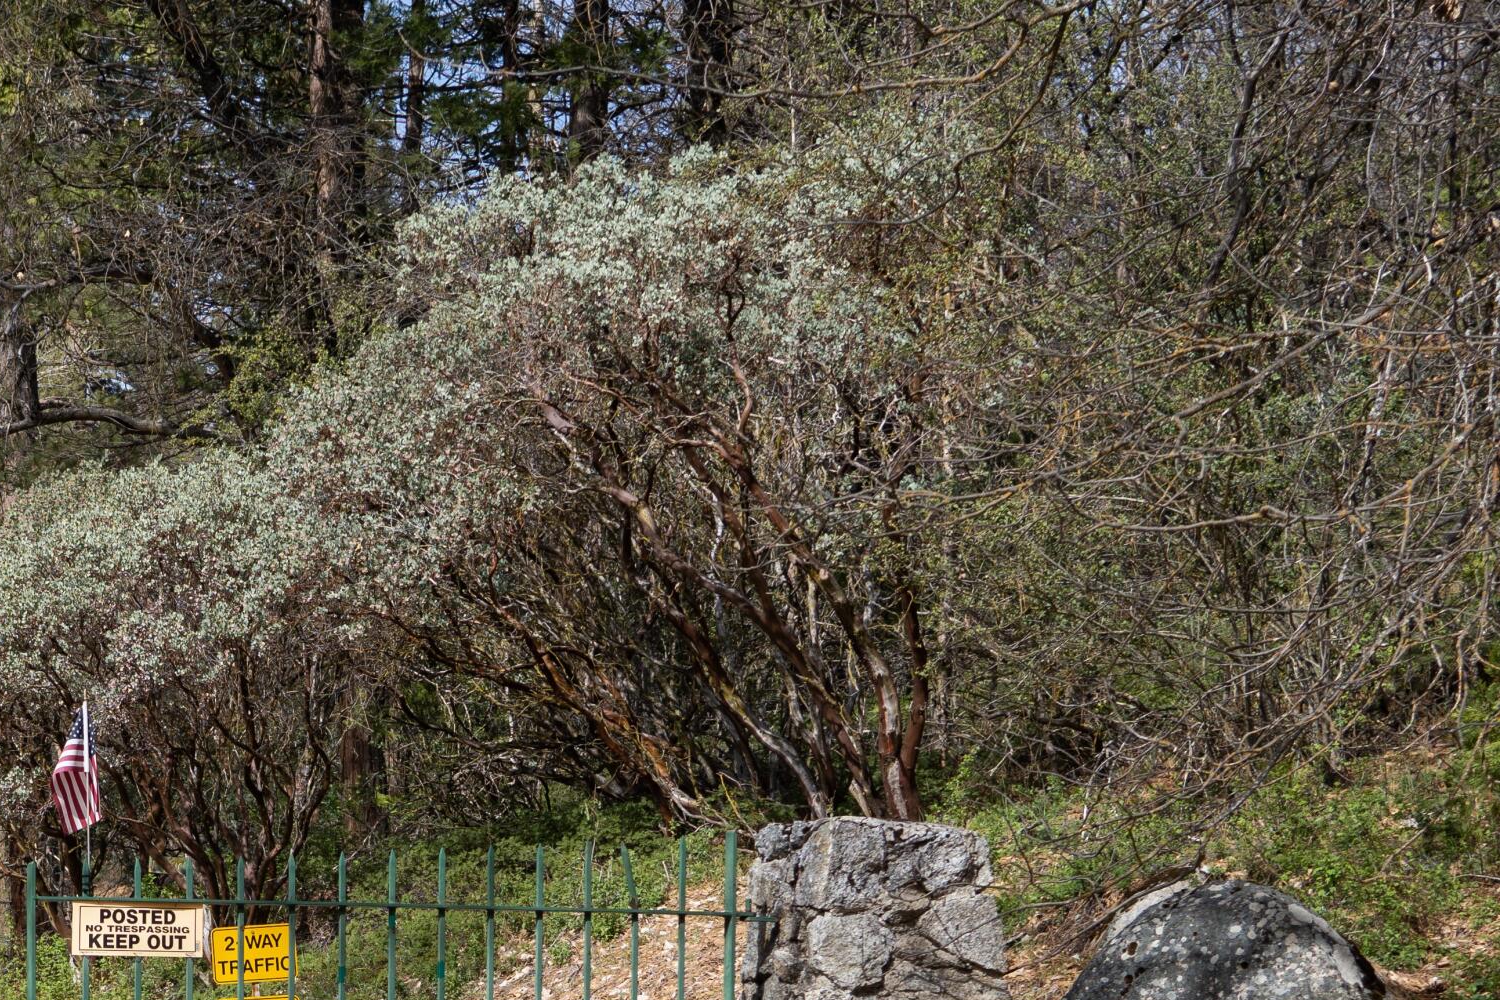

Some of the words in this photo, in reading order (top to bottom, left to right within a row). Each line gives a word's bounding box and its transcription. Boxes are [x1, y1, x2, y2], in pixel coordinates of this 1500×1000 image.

[100, 908, 176, 925] POSTED
[85, 924, 103, 932] NO
[107, 925, 190, 934] TRESPASSING
[88, 934, 140, 949] KEEP
[147, 934, 187, 950] OUT
[224, 933, 282, 951] 2WAY
